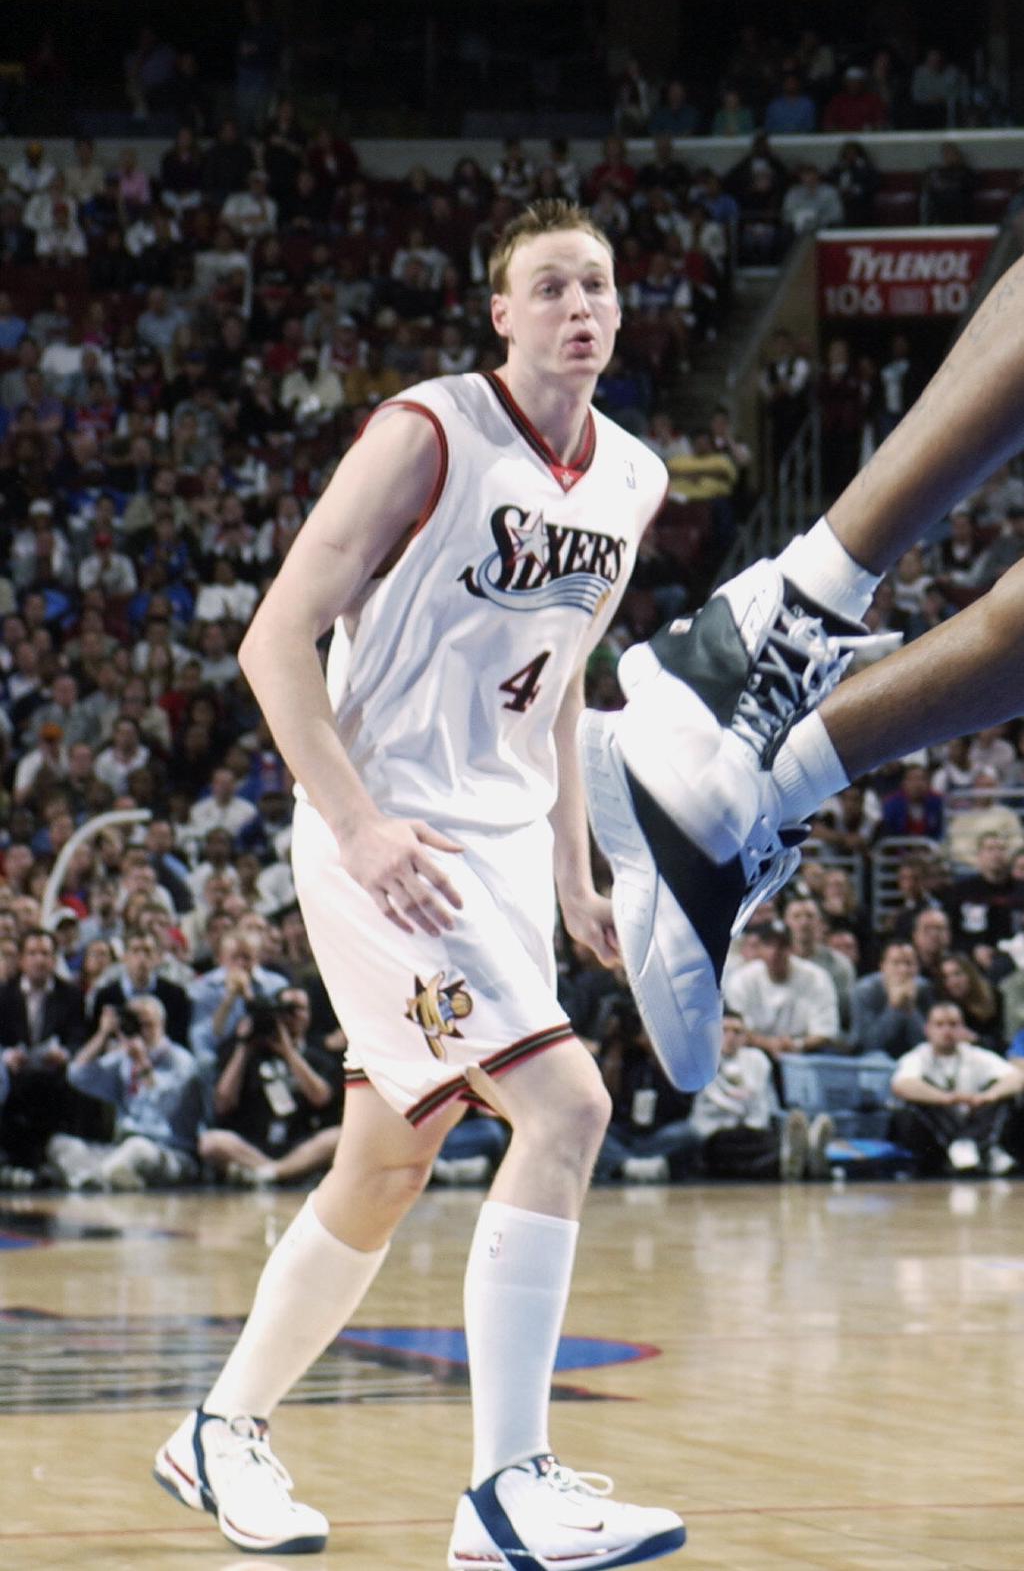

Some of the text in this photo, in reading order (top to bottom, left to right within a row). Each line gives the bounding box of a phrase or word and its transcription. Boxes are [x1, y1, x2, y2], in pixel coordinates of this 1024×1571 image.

[848, 246, 973, 281] TYLENOL
[824, 283, 883, 316] 106
[930, 281, 971, 314] 10
[457, 504, 628, 599] SIXERS
[498, 649, 552, 713] 4
